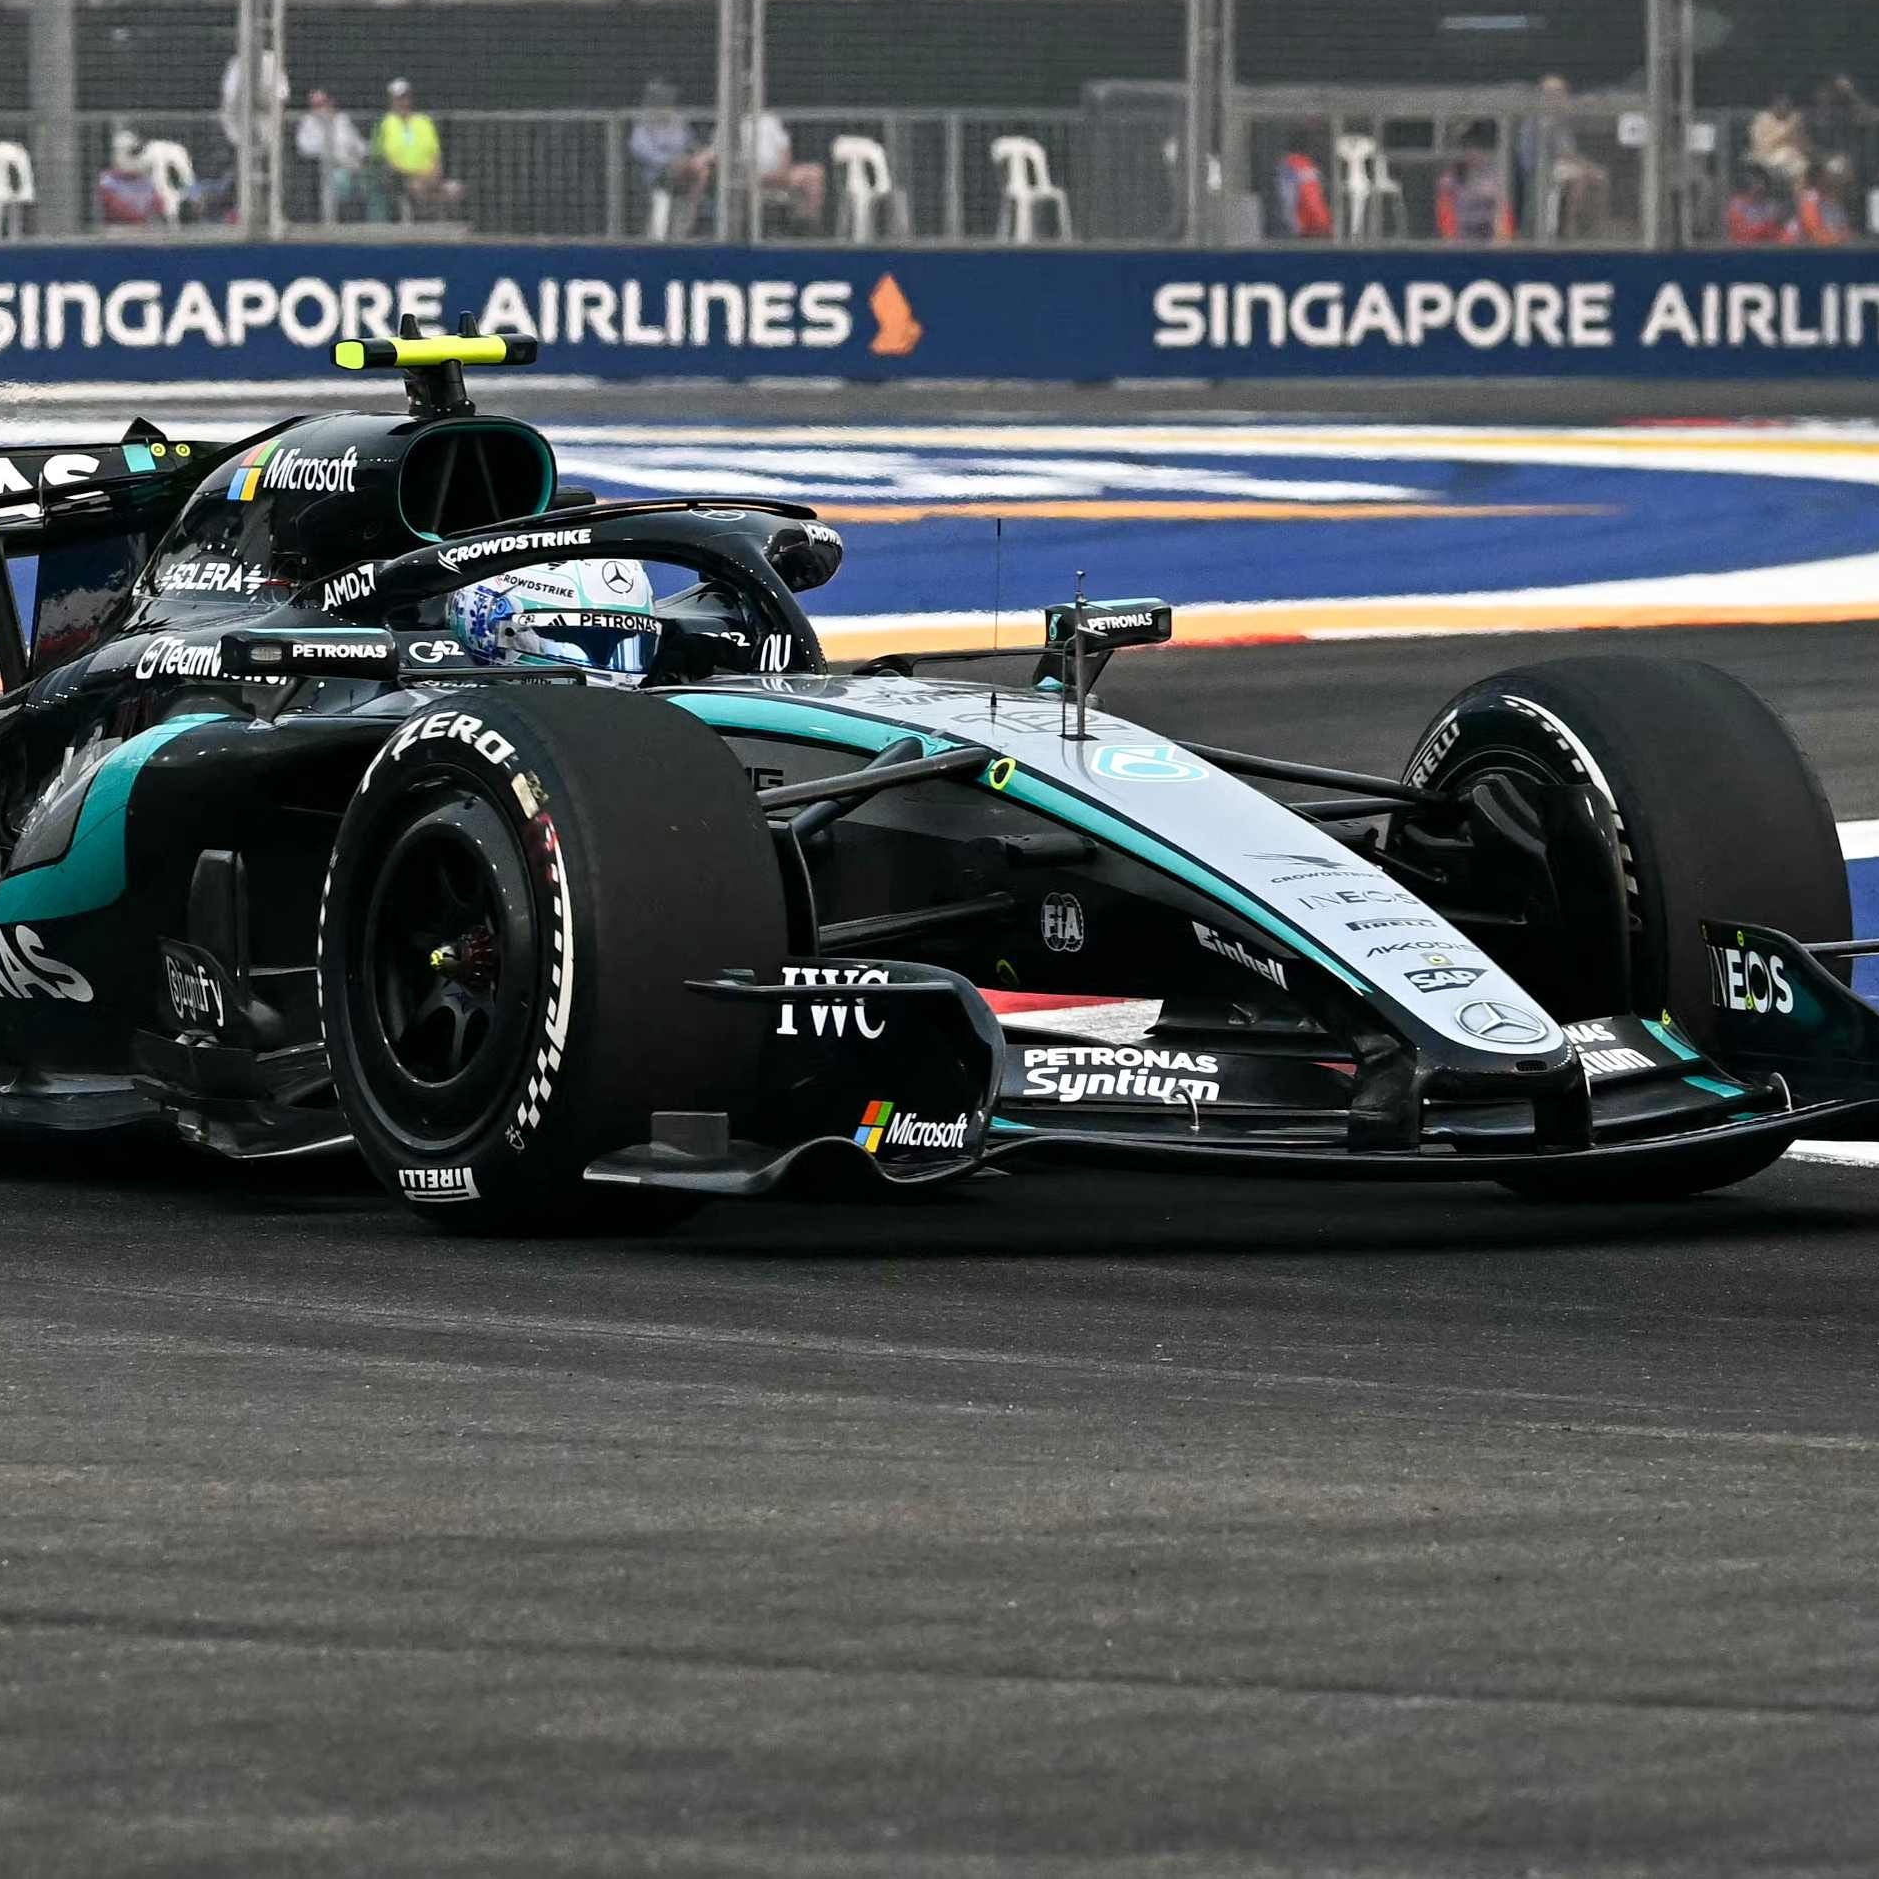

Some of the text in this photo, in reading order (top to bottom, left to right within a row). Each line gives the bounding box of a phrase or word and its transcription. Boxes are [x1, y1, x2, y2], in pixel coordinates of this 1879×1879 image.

[478, 279, 851, 347] AIRLINES
[1154, 281, 1614, 347] SINGAPORE
[262, 445, 358, 492] Microsoft
[446, 528, 592, 563] CROWDSTRIKE
[169, 562, 243, 593] SOLERA
[322, 571, 361, 612] AMD
[580, 613, 658, 634] PETRONAS
[1087, 612, 1153, 632] PETRONAS
[292, 643, 388, 659] PETRONAS
[390, 711, 517, 765] ZERO
[1297, 889, 1421, 911] INEOS
[1191, 920, 1289, 991] Einhell
[1409, 969, 1477, 991] SAP
[776, 967, 889, 1039] IWC
[1024, 1047, 1219, 1073] PETRONAS
[1023, 1067, 1220, 1104] Syntium
[885, 1112, 968, 1148] Microsoft
[398, 1166, 481, 1203] PIRELLI
